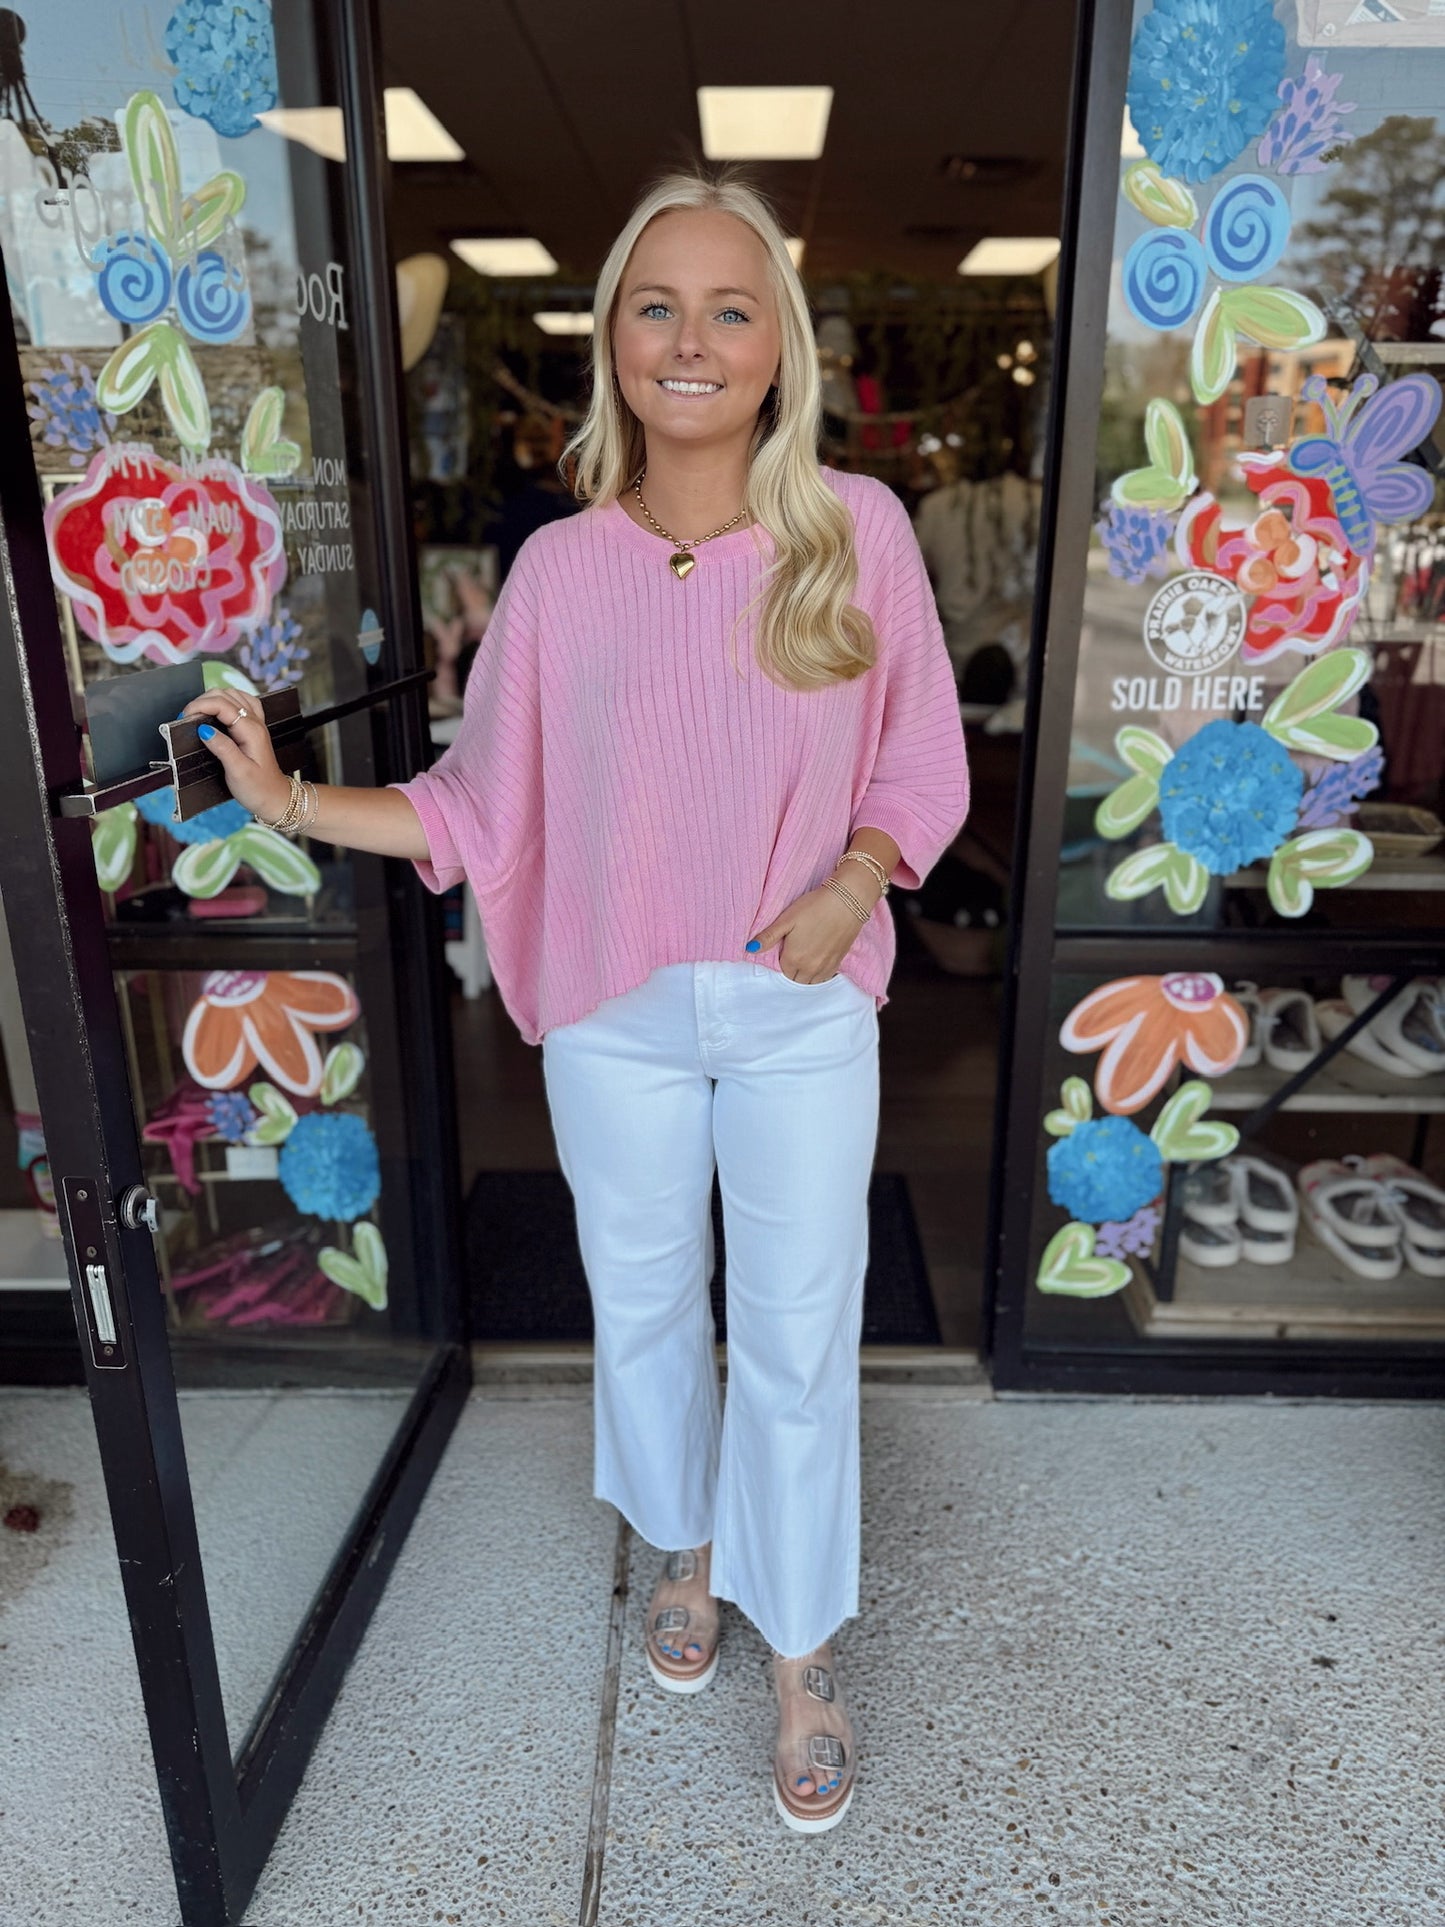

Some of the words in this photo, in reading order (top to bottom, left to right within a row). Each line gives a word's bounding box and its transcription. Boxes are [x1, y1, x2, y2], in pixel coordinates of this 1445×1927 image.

[1149, 582, 1185, 640] PRAIRIE
[1111, 676, 1182, 711] SOLD
[1191, 675, 1265, 711] HERE
